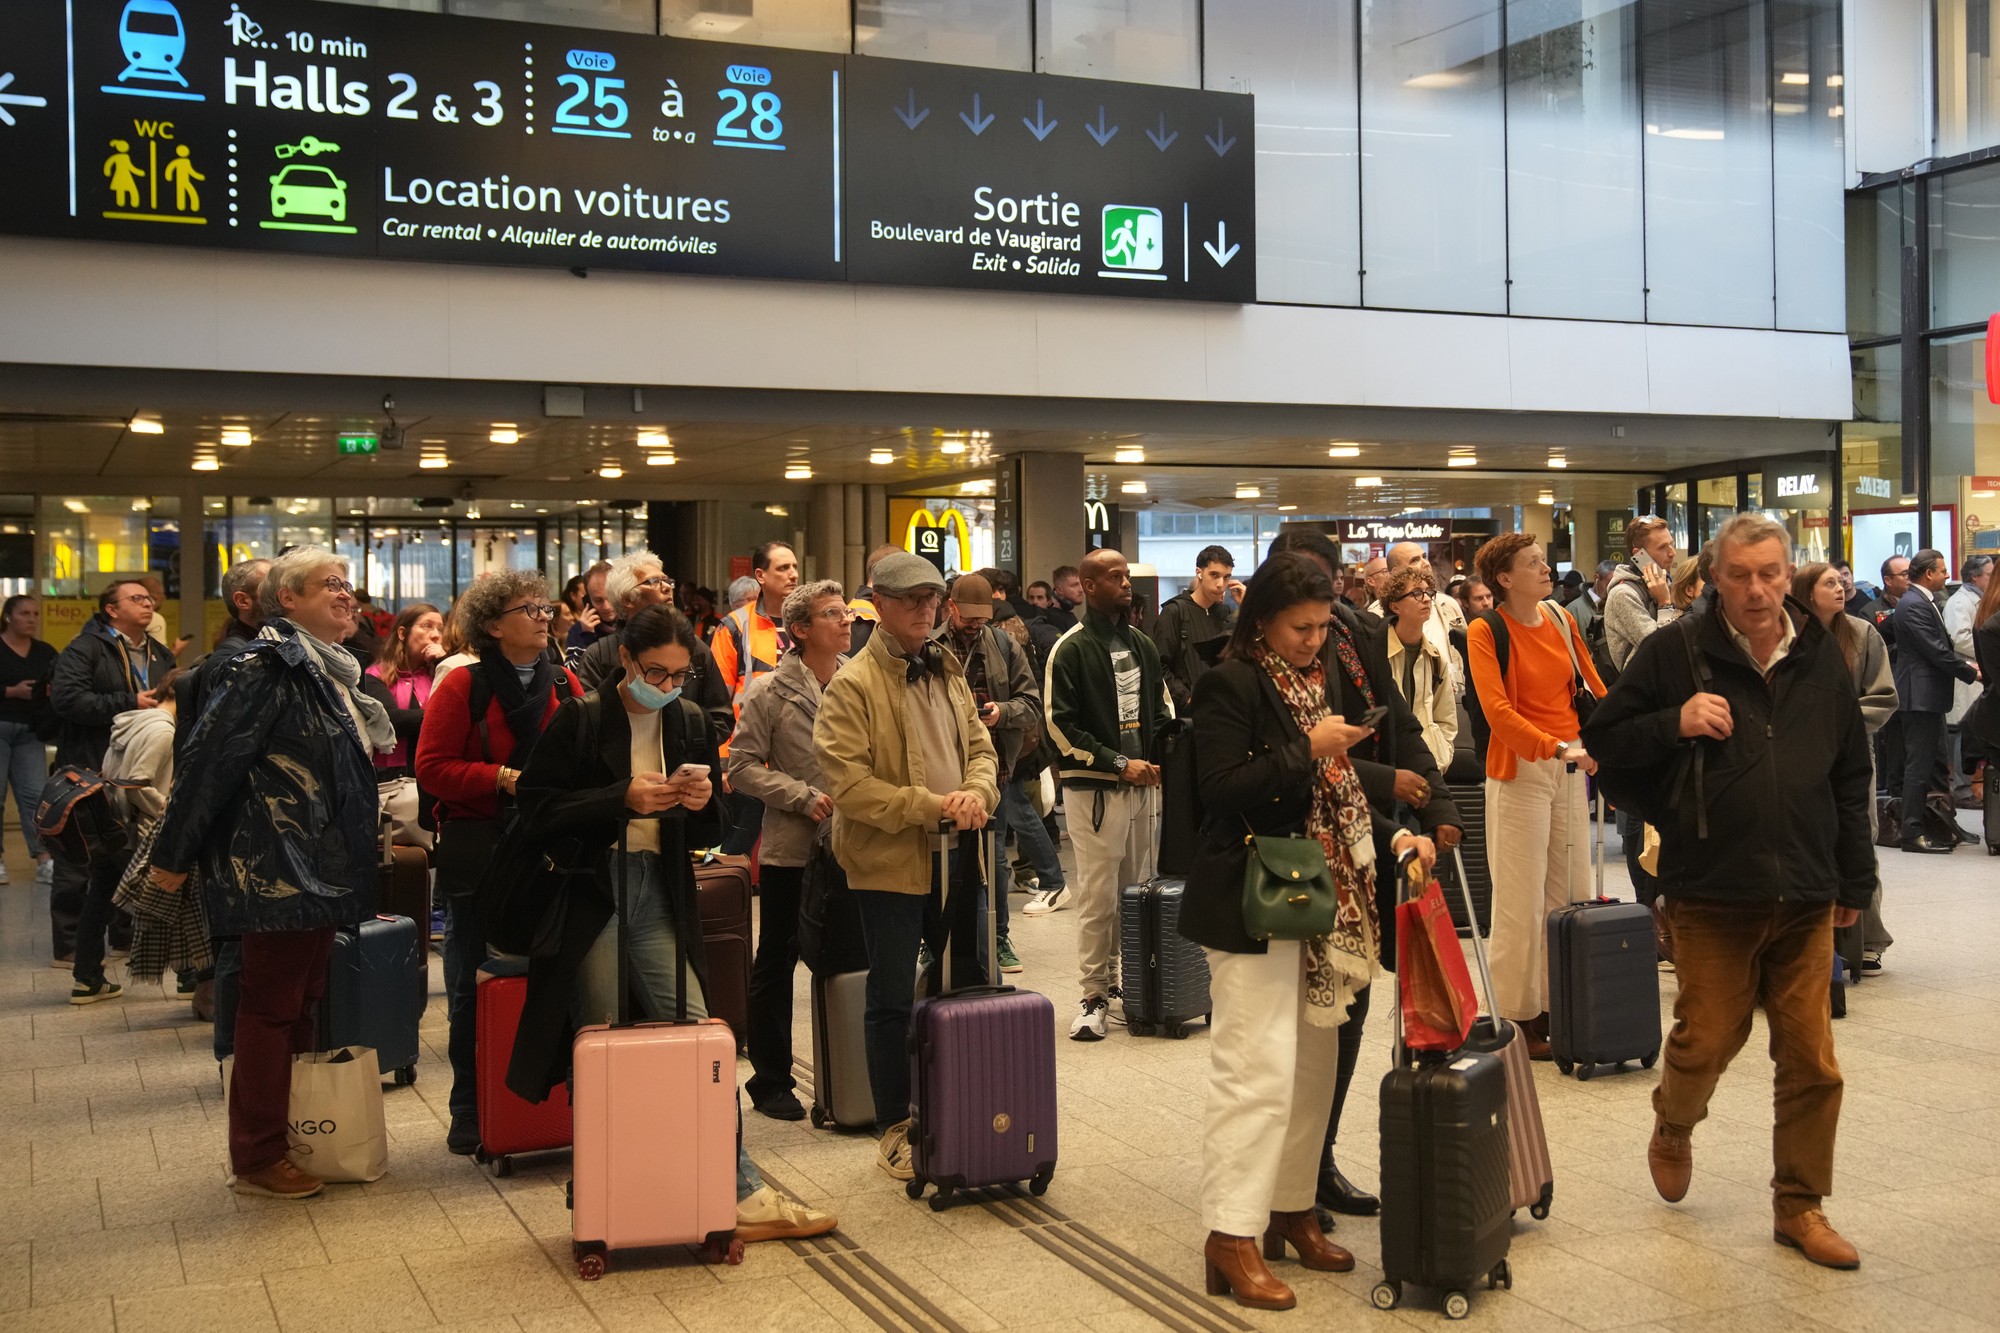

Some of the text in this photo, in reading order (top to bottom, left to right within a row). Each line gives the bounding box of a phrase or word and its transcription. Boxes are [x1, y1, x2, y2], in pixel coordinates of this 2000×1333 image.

[286, 31, 367, 58] 10 min
[572, 52, 609, 69] Voie
[731, 68, 766, 84] Voie
[224, 57, 504, 127] Halls 2 & 3
[555, 73, 784, 141] 25 à 28
[133, 118, 175, 139] WC
[652, 126, 696, 144] to a
[384, 166, 731, 224] Location voitures
[973, 186, 1081, 227] Sortie
[382, 217, 718, 255] Car rental Alquiler de automóviles
[870, 220, 1081, 253] Boulevard de Vaugirard
[971, 251, 1081, 276] Exit Salida
[1348, 523, 1368, 538] La
[1001, 540, 1012, 559] 23
